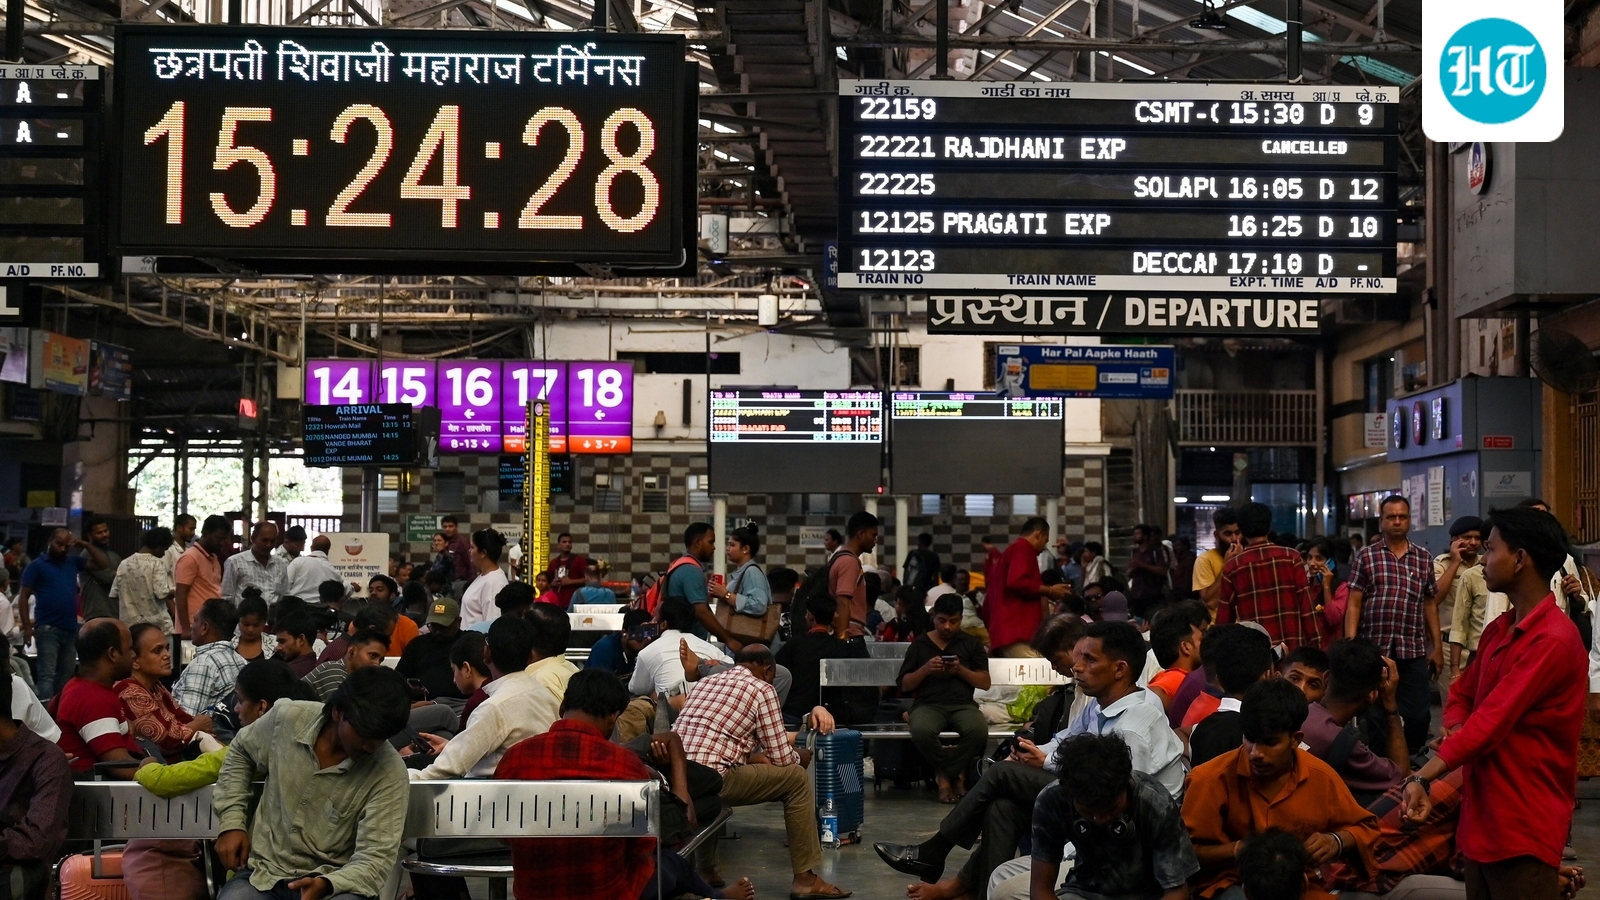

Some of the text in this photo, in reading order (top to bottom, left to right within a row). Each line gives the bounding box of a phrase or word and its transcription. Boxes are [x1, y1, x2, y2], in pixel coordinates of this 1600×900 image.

[149, 40, 645, 86] छत्रपती शिवाजी महाराज टर्मिनस
[16, 82, 32, 103] A
[855, 82, 889, 95] गाडी
[982, 84, 1071, 98] गाडी का नाम
[860, 98, 936, 120] 22159
[1229, 102, 1304, 124] 15:30
[1320, 104, 1335, 124] D
[1358, 104, 1373, 125] 9
[16, 121, 32, 142] A
[860, 136, 1347, 160] 22221 RAJDHANI EXP CANCELLED
[143, 101, 660, 232] 15:24:28
[860, 173, 936, 195] 22225
[1229, 177, 1304, 200] 16:05
[1319, 179, 1335, 200] D
[1349, 179, 1379, 200] 12
[859, 211, 1378, 238] 12125 PRAGATI EXP 16:25 D 10
[7, 265, 30, 276] A/D
[51, 265, 86, 277] PF. NO.
[859, 250, 935, 271] 12123
[1227, 253, 1302, 274] 17:10
[1318, 254, 1334, 275] D
[856, 273, 924, 284] TRAIN NO
[1007, 274, 1097, 286] TRAIN NAME
[1230, 277, 1304, 288] EXPT. TIME
[1315, 277, 1338, 288] A/D
[1350, 278, 1384, 289] PF. NO.
[930, 294, 1088, 326] प्रस्थान
[1125, 298, 1319, 328] DEPARTURE
[1041, 348, 1158, 360] Har Pal Aapke Haath
[314, 367, 362, 405] 14
[382, 367, 427, 407] 15
[446, 368, 493, 406] 16
[512, 368, 558, 407] 17
[577, 369, 624, 408] 18
[336, 406, 383, 415] ARRIVAL
[451, 439, 478, 448] 8-13
[595, 440, 617, 449] 3-7
